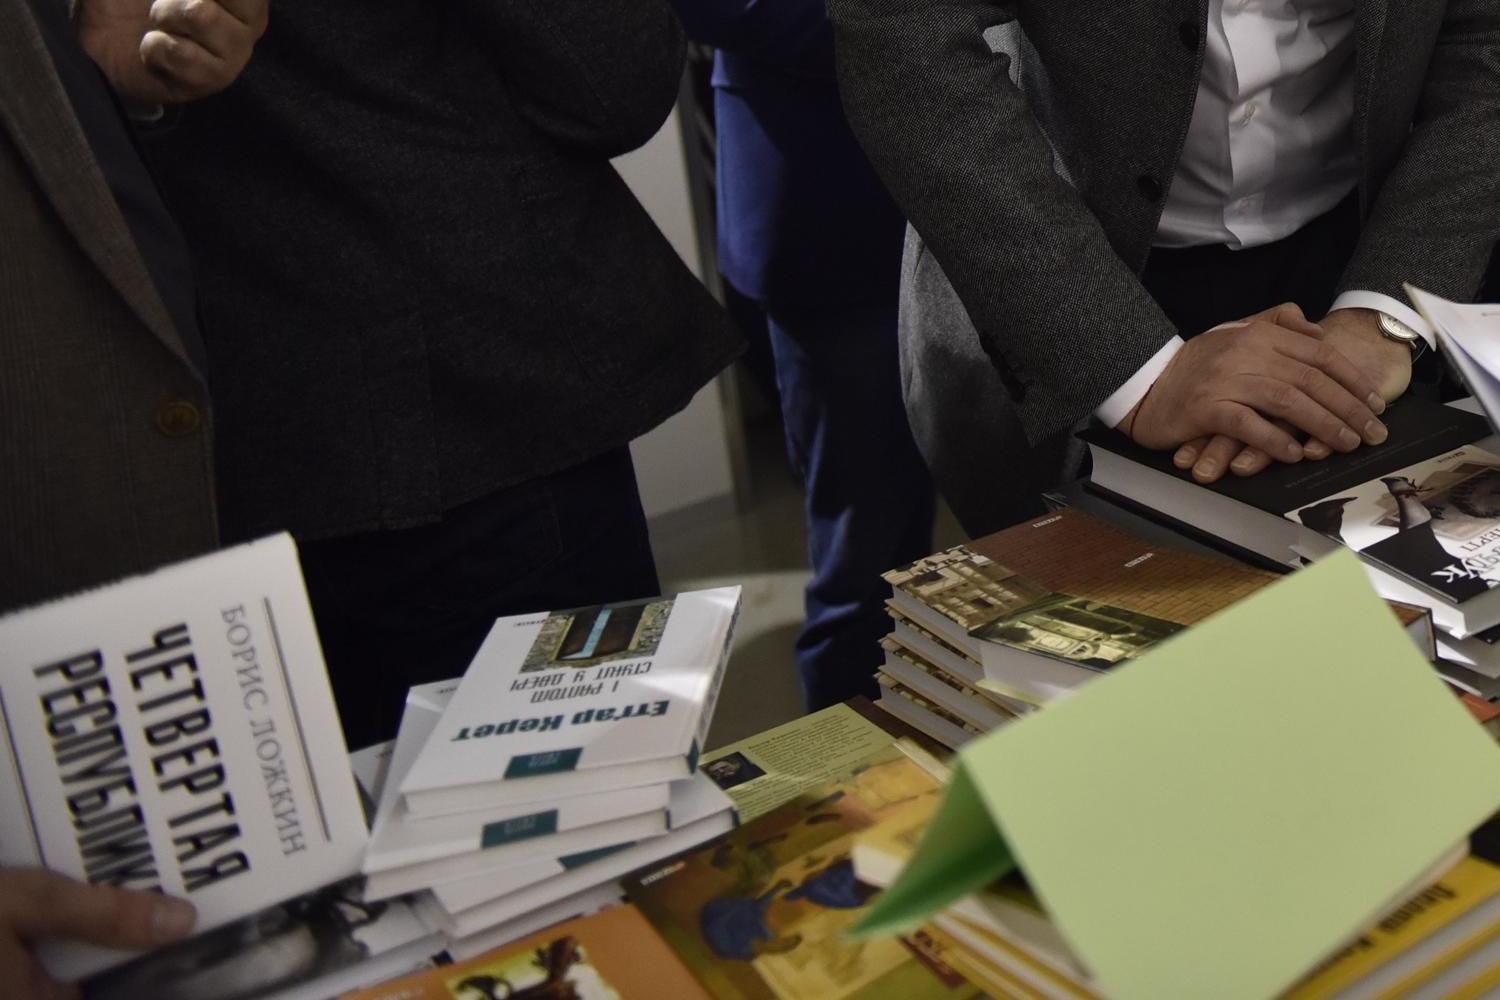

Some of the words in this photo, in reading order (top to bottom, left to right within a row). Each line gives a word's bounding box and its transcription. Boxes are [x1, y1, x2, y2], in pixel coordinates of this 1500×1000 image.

[510, 672, 566, 692] ДВЕРІ
[530, 683, 604, 703] РАПТОМ
[571, 699, 670, 725] Етґар
[221, 603, 273, 712] БОРИС
[250, 712, 309, 859] ЛОЖКИН
[450, 714, 565, 742] Керет
[125, 621, 251, 893] ЧЕТВЕРТАЯ
[32, 649, 164, 896] РЕСПУБЛИК
